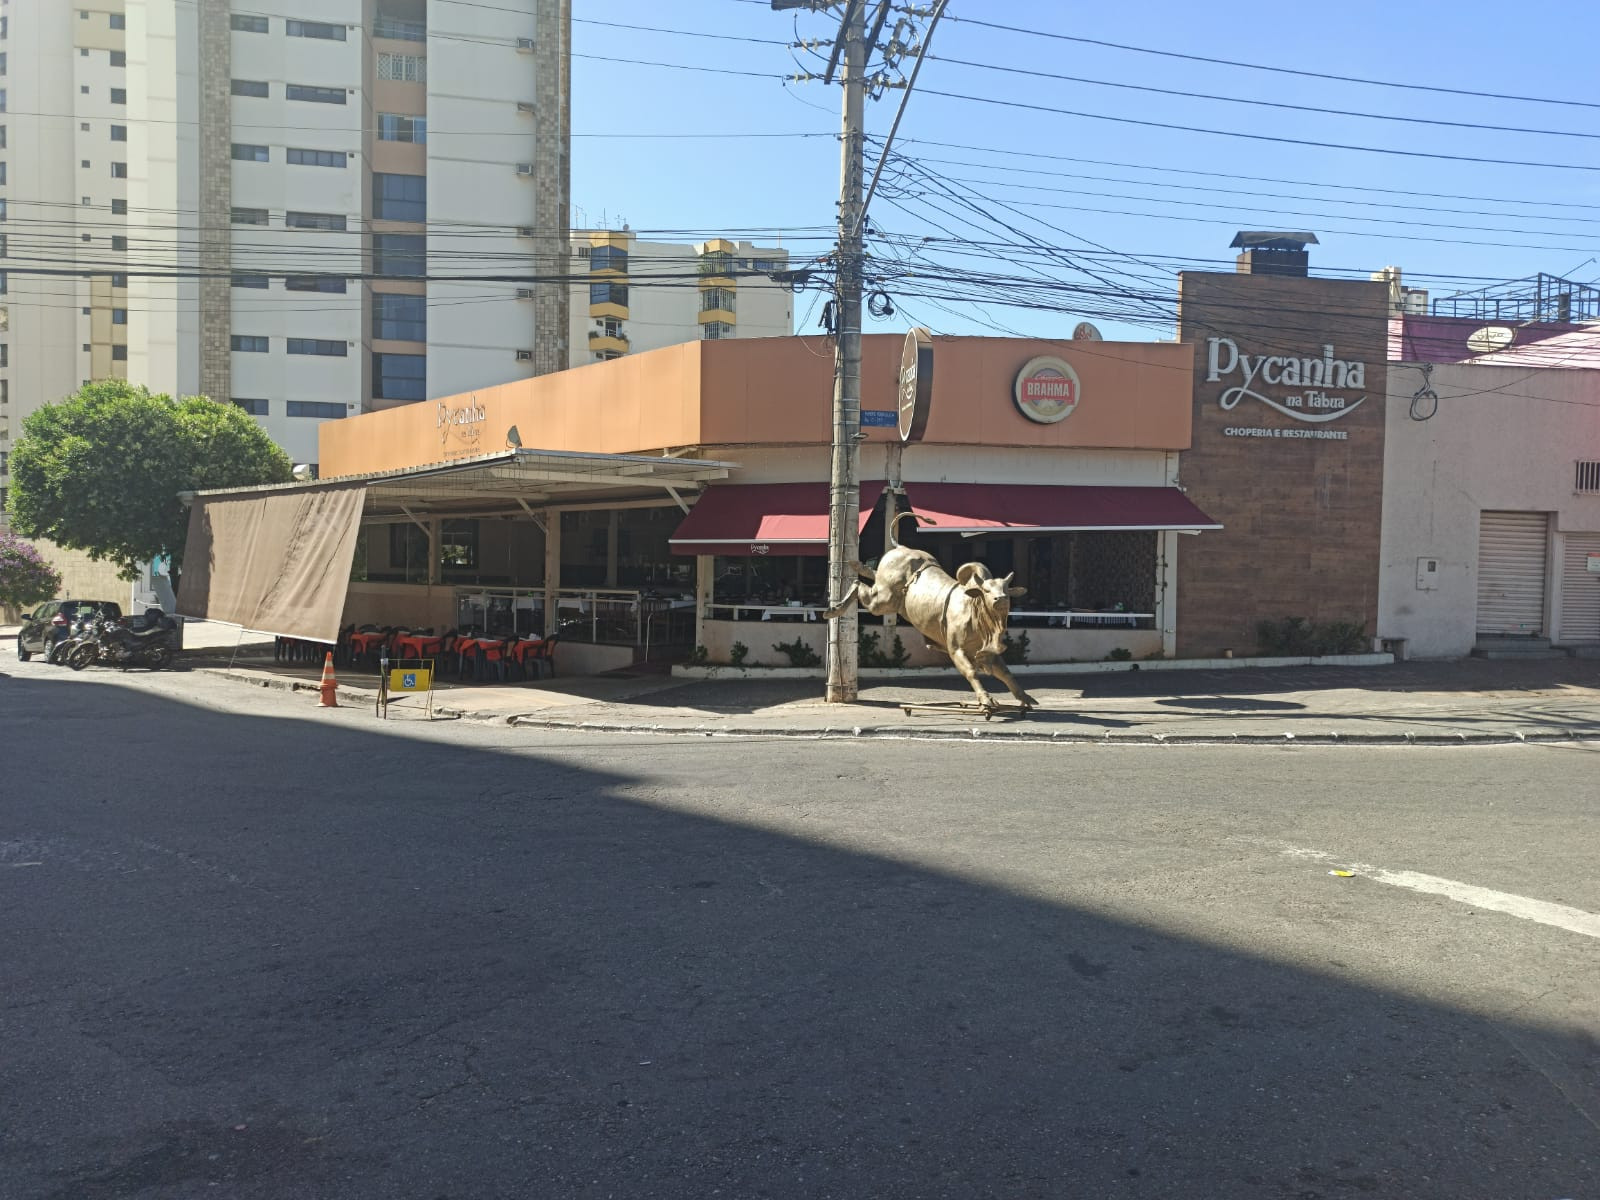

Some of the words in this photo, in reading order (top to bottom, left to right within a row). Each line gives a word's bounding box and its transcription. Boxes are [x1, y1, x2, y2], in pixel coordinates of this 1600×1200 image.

[1206, 337, 1366, 410] Pycanha
[1027, 382, 1070, 397] BRAHMA
[1286, 396, 1302, 407] na
[1224, 427, 1273, 438] CHOPERIA
[1273, 429, 1281, 438] E
[1282, 429, 1348, 440] RESTAURANTE
